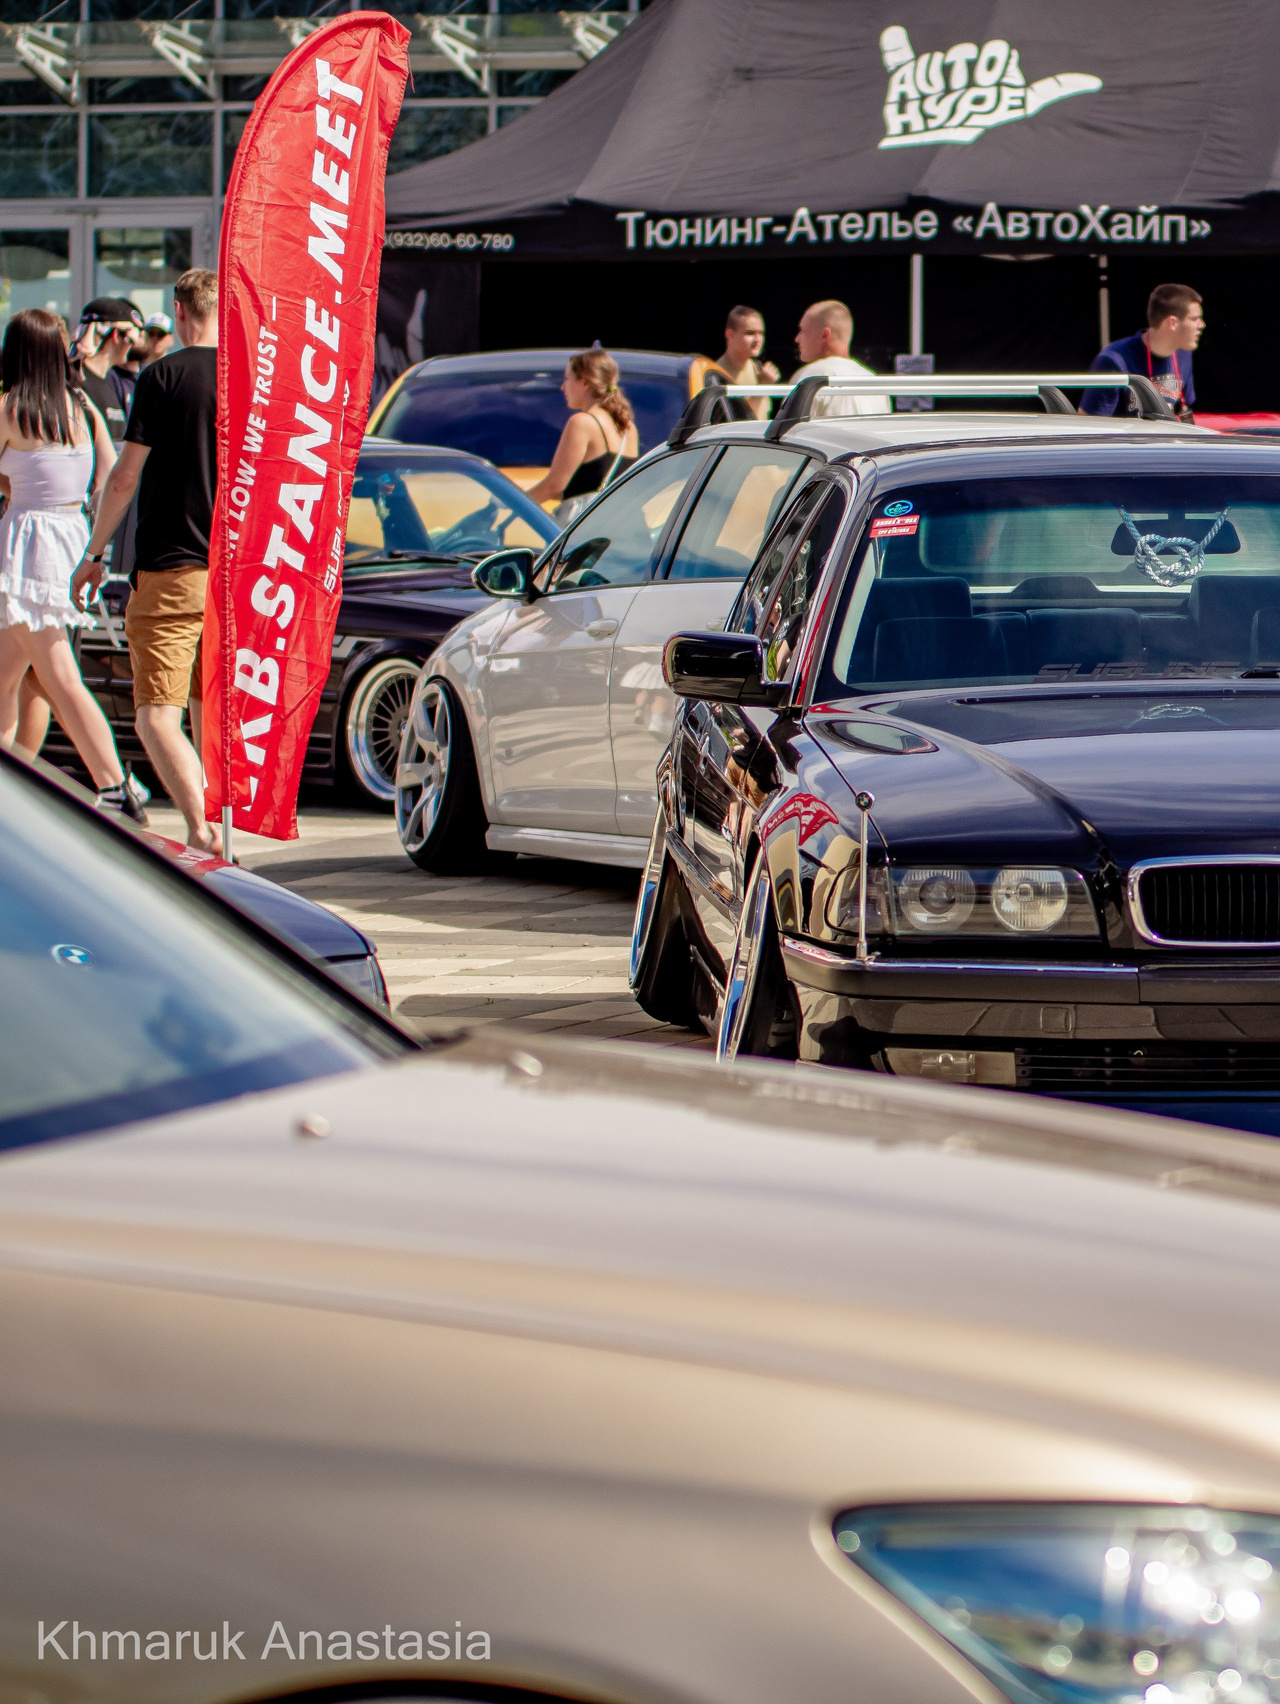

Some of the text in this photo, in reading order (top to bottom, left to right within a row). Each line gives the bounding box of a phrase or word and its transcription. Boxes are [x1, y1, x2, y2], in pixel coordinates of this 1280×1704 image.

[886, 39, 1010, 103] AUTO
[883, 86, 1026, 136] HYPE
[616, 202, 1212, 248] Тюнинг-Ателье «АвтоХайп»
[252, 326, 279, 406] TRUST
[242, 413, 267, 453] WE
[229, 458, 257, 522] LOW
